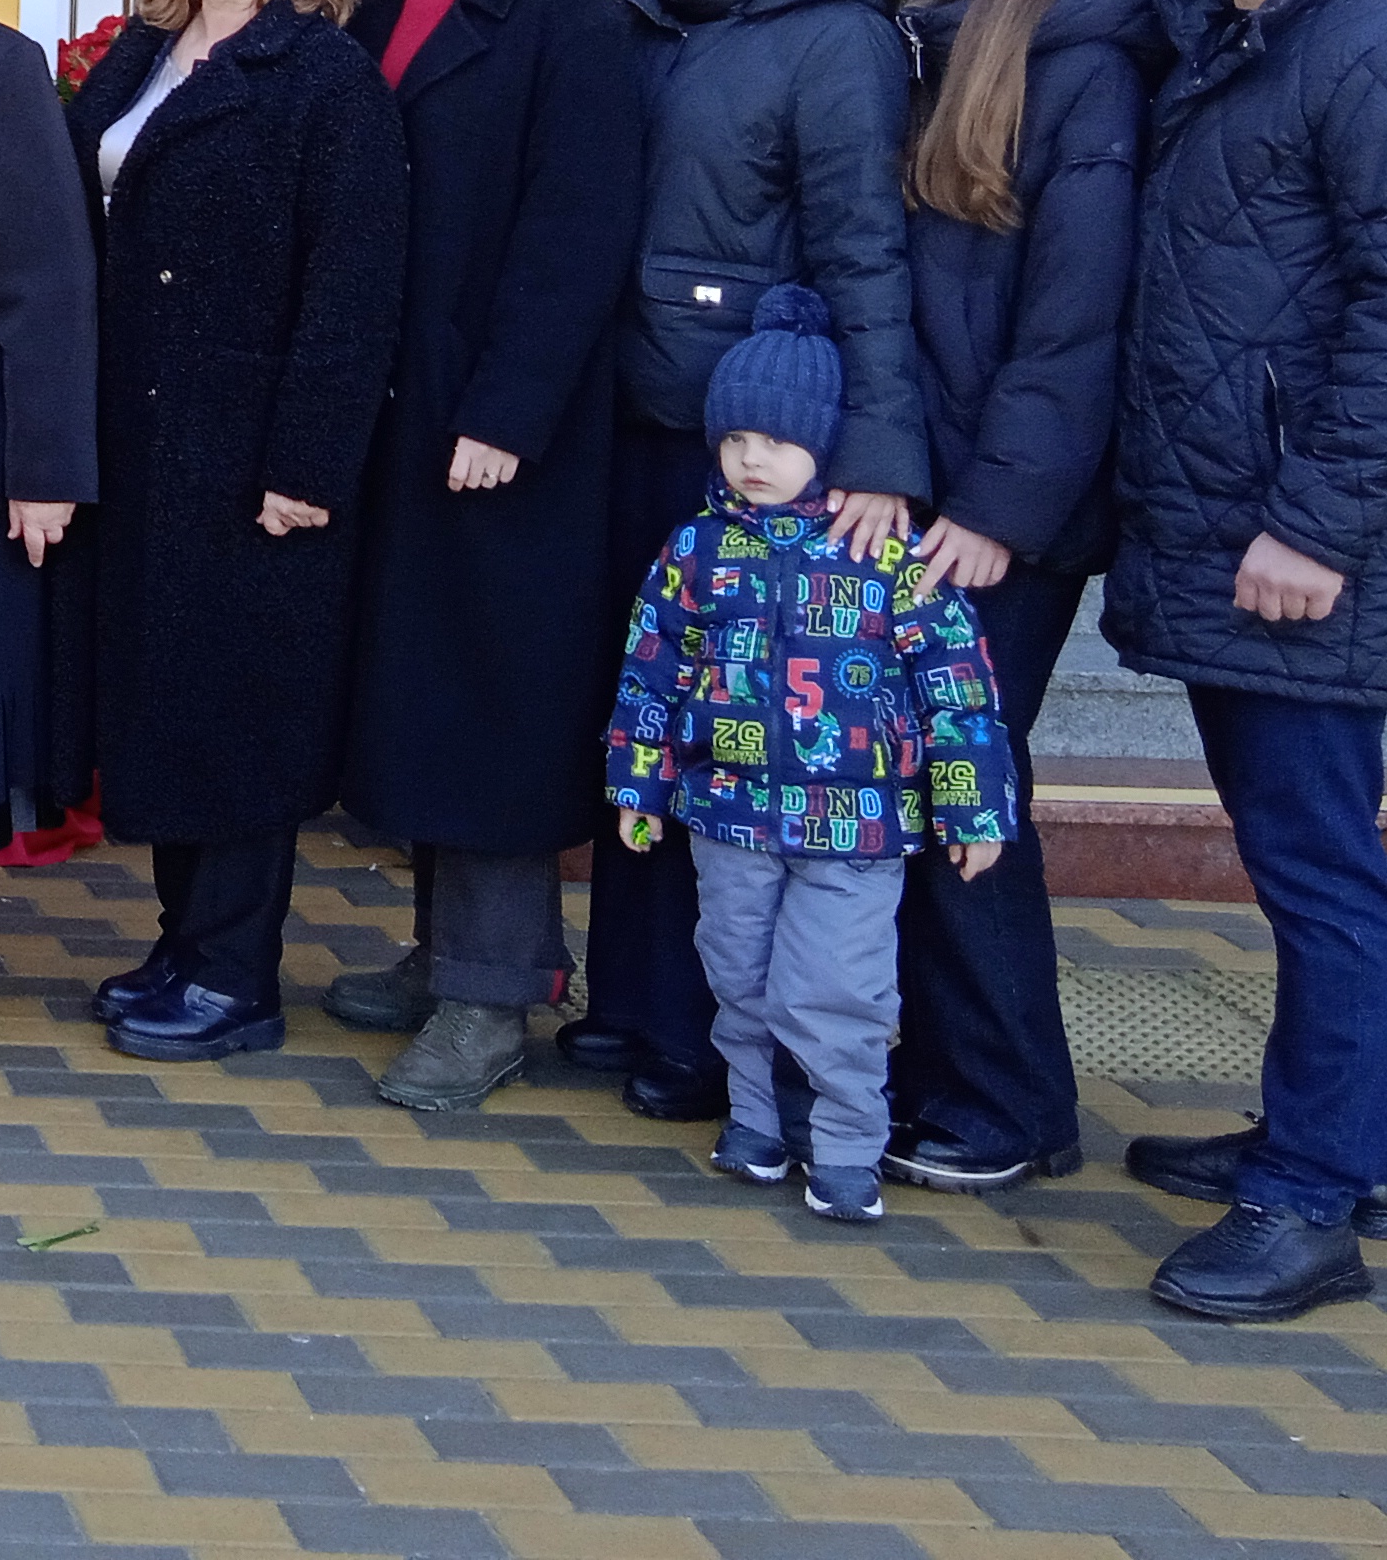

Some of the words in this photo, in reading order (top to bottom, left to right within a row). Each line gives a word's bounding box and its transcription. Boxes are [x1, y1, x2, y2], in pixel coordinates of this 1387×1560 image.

[795, 604, 885, 640] LUB
[785, 657, 824, 719] 5
[781, 784, 883, 820] DINO
[781, 814, 885, 853] CLUB
